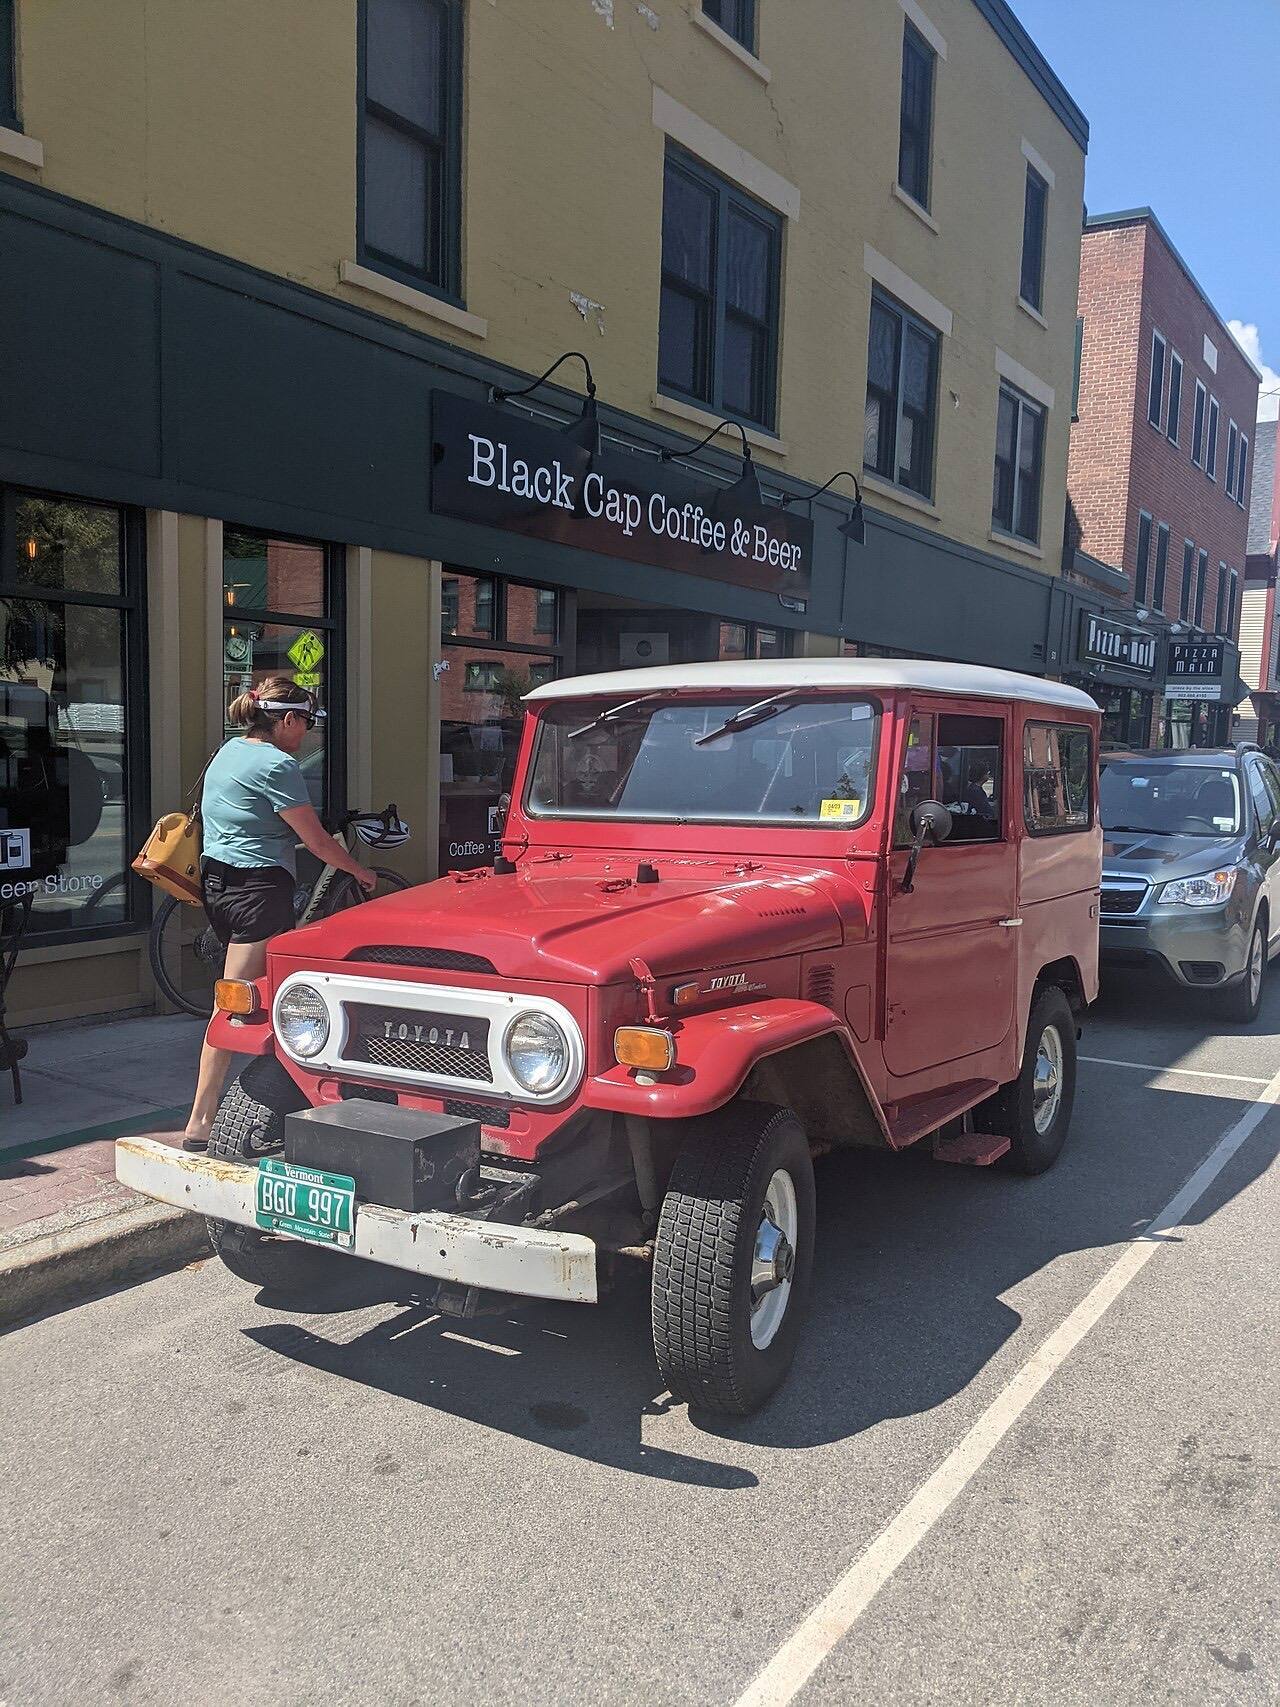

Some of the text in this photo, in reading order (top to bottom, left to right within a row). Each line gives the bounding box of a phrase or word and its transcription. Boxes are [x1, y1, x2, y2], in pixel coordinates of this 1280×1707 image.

[467, 433, 802, 571] Black Cap Coffee & Beer
[1174, 646, 1218, 658] PIZZA
[449, 841, 485, 857] Coffee
[0, 874, 103, 899] eer Store
[710, 973, 746, 990] TOYOTA
[384, 1021, 470, 1049] TOYOTA
[284, 1165, 324, 1184] Vermont
[262, 1177, 345, 1228] BGD 997
[294, 1224, 316, 1236] Mountain
